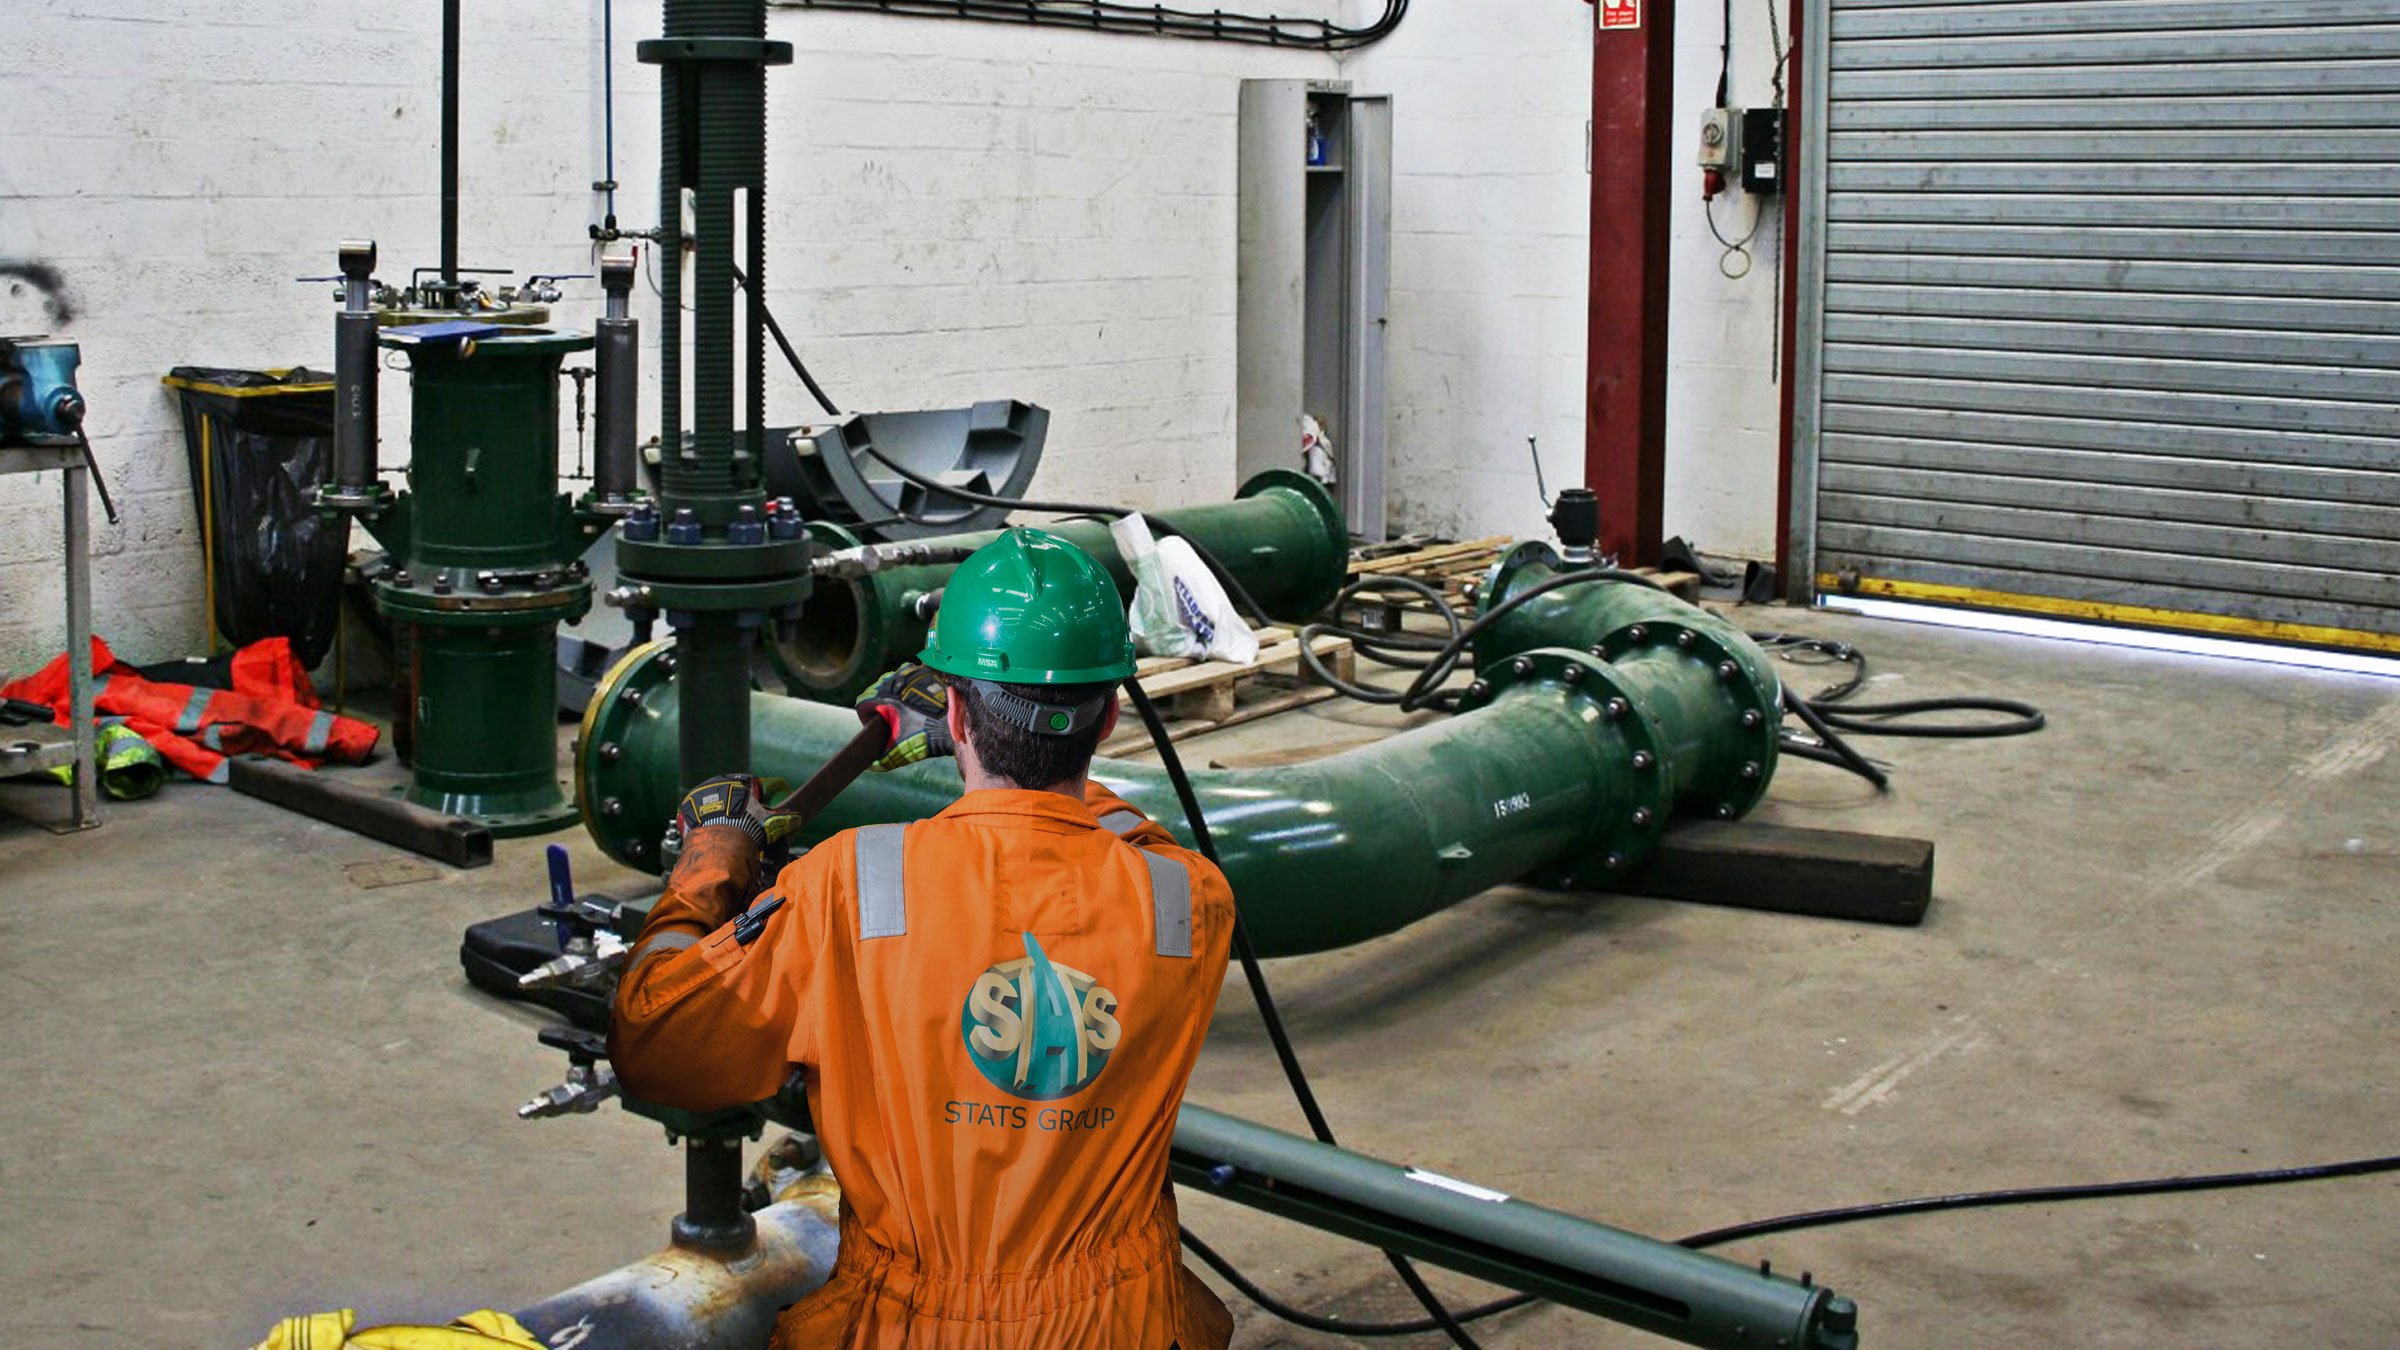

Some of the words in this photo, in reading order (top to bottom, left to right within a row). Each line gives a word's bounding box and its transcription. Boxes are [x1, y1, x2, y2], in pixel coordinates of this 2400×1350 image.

[977, 656, 999, 669] MSA
[944, 1101, 1027, 1129] STATS
[1037, 1107, 1115, 1132] GROUP
